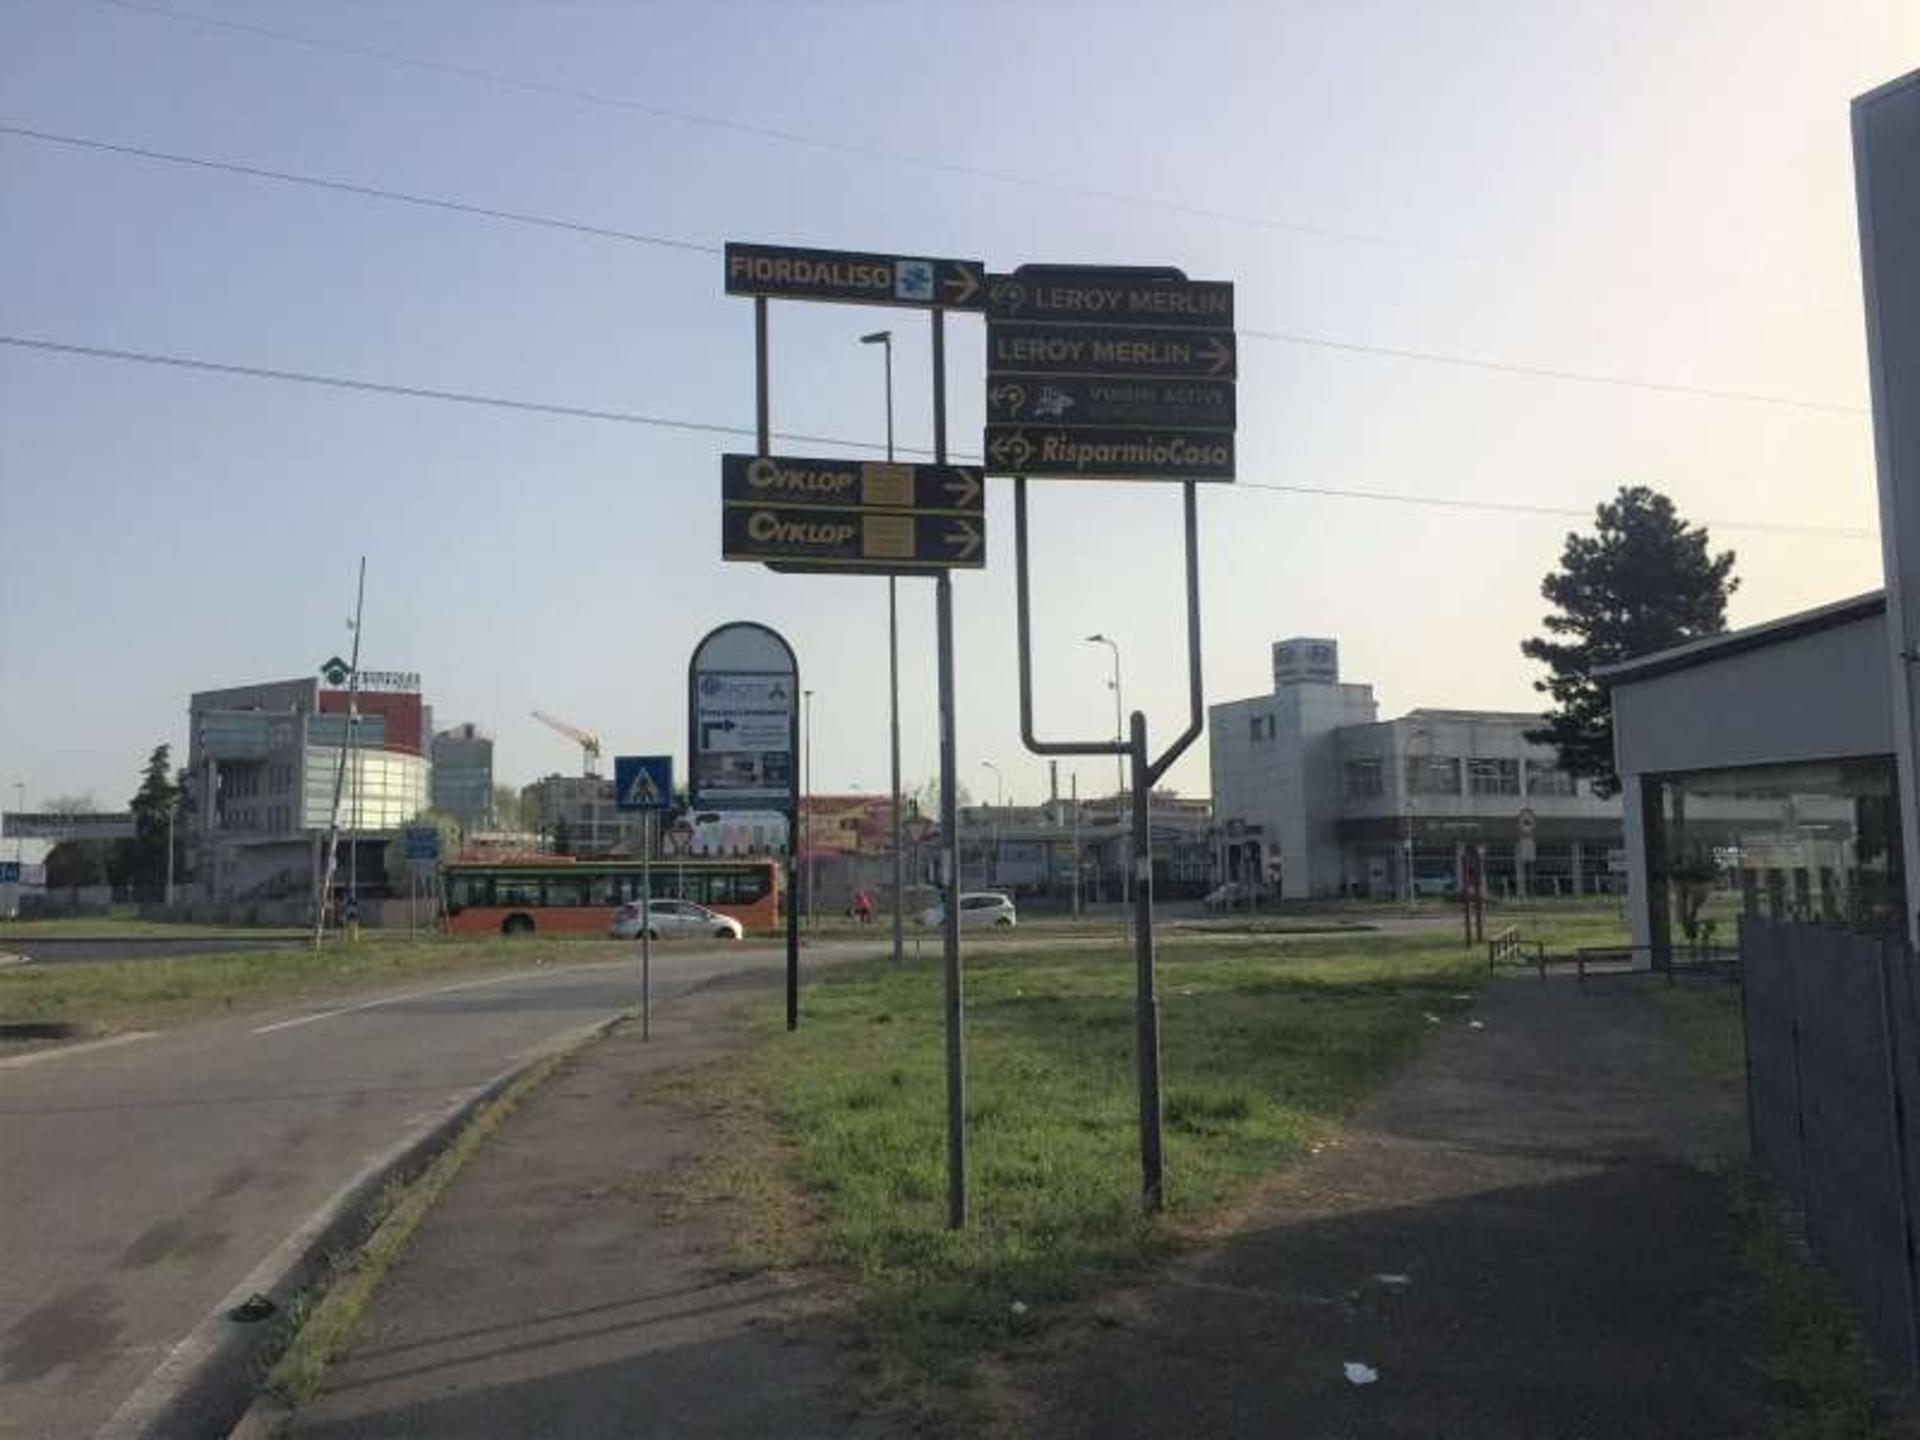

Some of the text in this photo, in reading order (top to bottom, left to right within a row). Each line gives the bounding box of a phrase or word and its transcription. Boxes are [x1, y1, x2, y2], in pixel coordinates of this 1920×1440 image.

[731, 256, 892, 290] FIORDALISO
[1035, 287, 1229, 314] LEROY MERLIN
[998, 338, 1192, 364] LEROY MERLIN
[1042, 433, 1229, 471] RisparmioCasa
